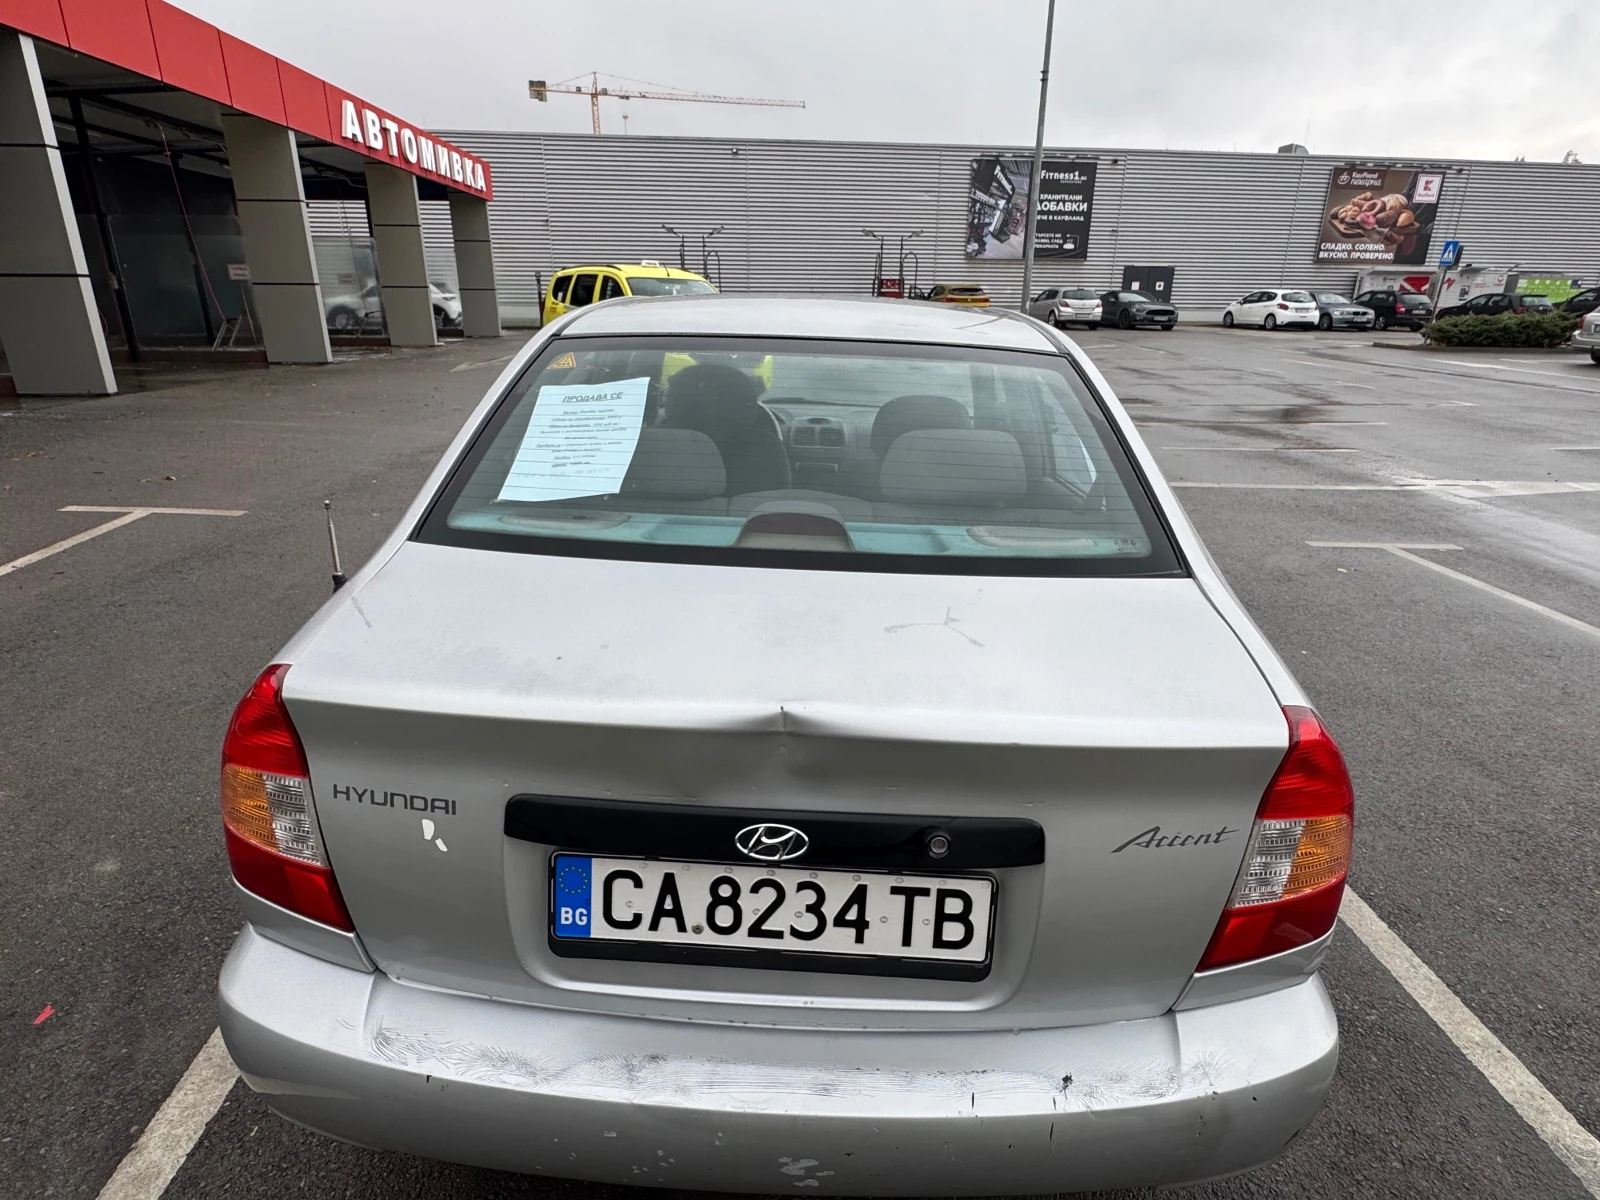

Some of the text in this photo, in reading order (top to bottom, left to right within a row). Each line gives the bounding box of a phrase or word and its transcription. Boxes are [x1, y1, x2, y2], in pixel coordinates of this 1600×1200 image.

[342, 100, 487, 192] АВТОМИВКА
[1352, 171, 1379, 179] Kaufland
[1319, 251, 1394, 260] ВКУСНО. ПРОВЕРЕНО.
[1321, 243, 1386, 251] СЛАДКО. СОЛЕНО.
[562, 391, 624, 403] ПРОДАВА СЕ
[333, 783, 457, 816] HYUNDAI
[1110, 825, 1239, 854] Accent
[560, 906, 588, 927] BG
[601, 869, 976, 951] CA 8234 TB
